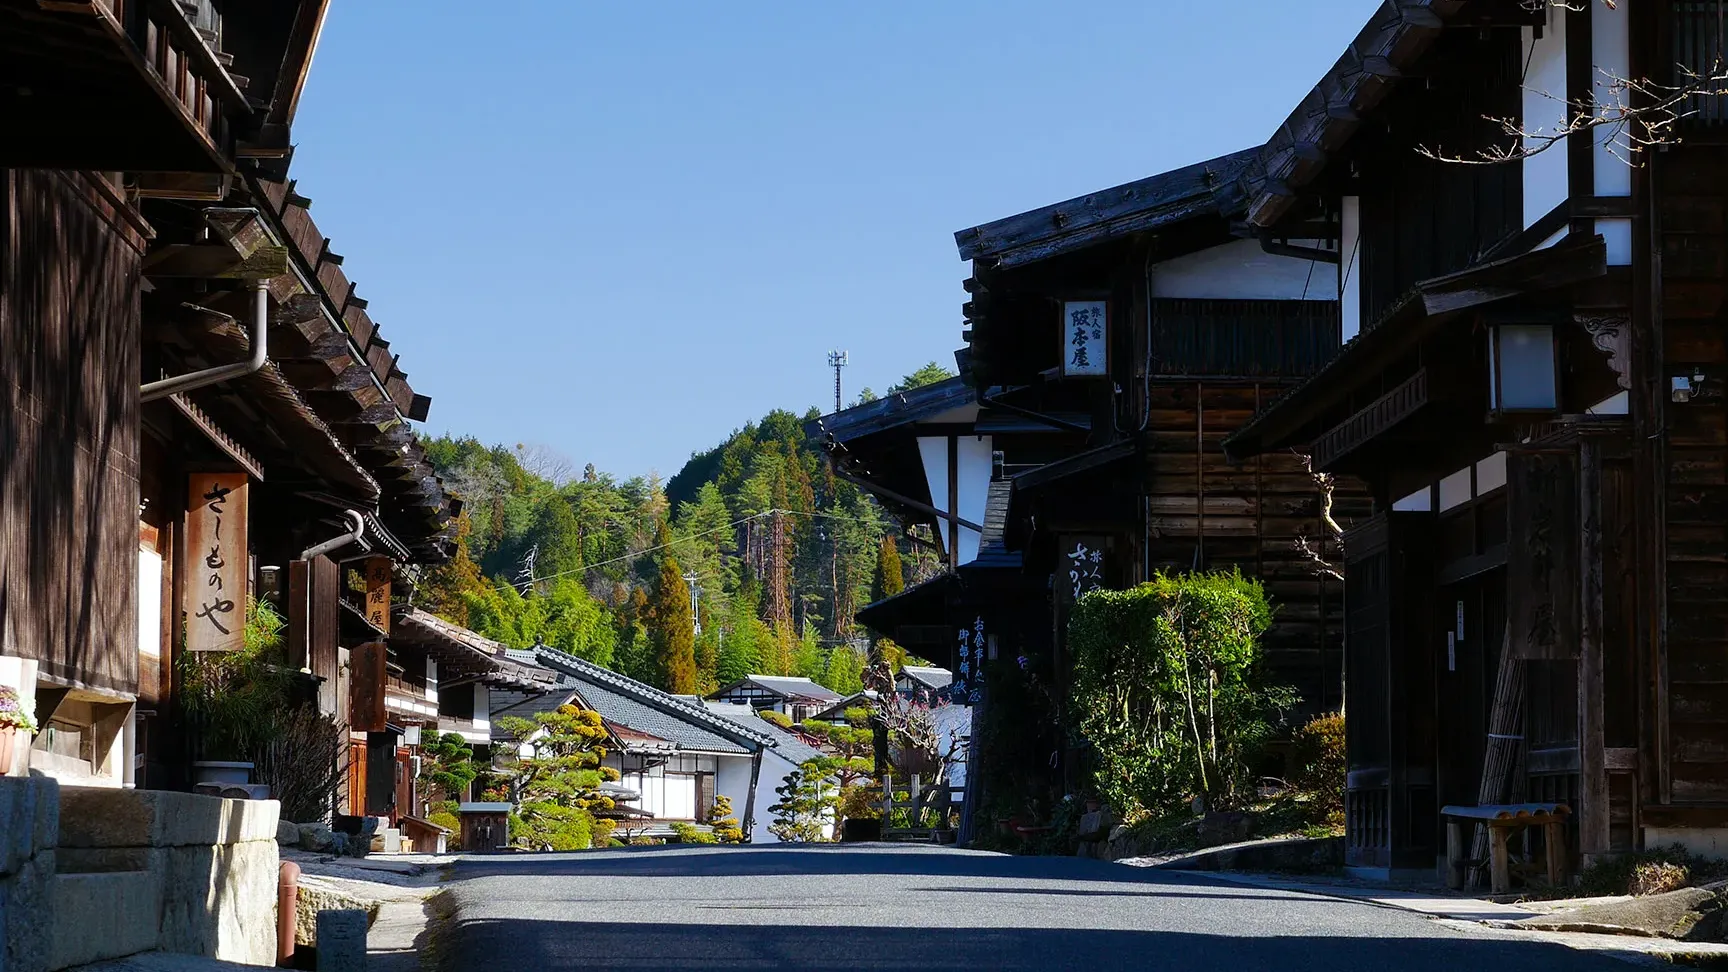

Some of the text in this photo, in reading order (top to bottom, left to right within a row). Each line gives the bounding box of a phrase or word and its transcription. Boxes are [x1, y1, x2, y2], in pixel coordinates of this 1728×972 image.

[1070, 308, 1091, 368] 阪本屋
[1090, 306, 1103, 340] 旅人宿
[195, 482, 235, 635] さしものや
